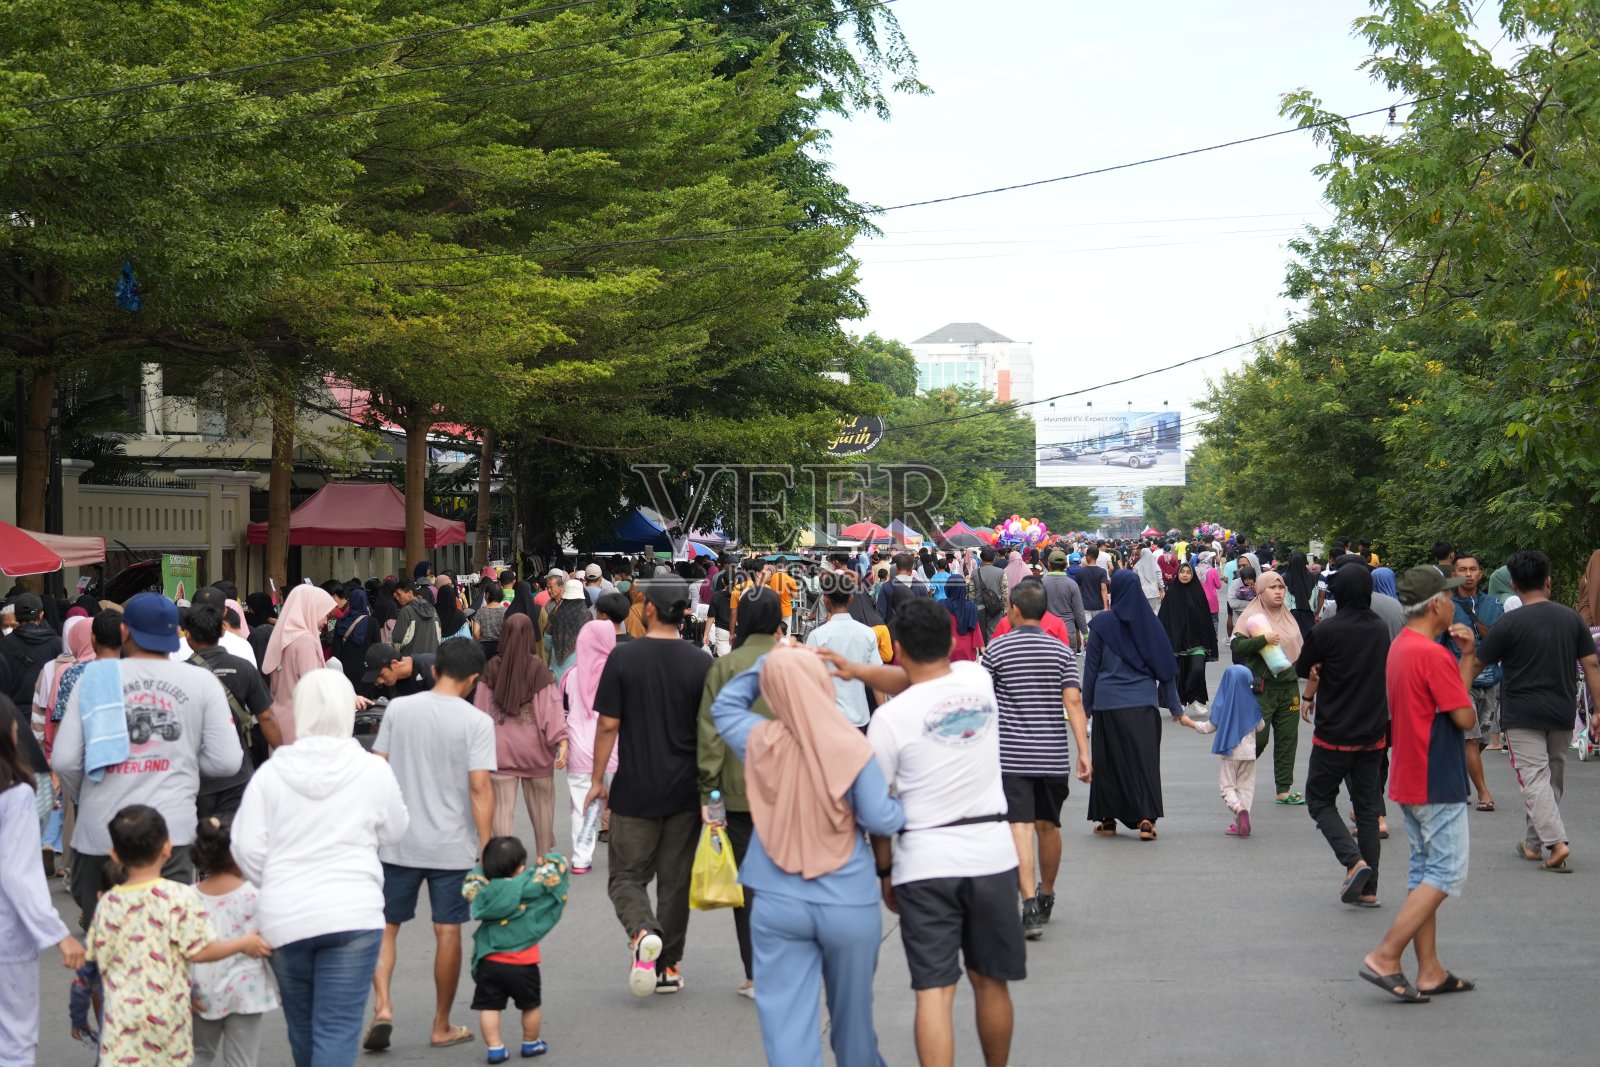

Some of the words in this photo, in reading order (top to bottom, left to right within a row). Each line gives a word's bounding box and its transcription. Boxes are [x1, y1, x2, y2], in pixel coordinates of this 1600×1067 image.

[143, 680, 154, 690] OF
[156, 680, 189, 704] CELEBES
[107, 759, 170, 774] OVERLAND
